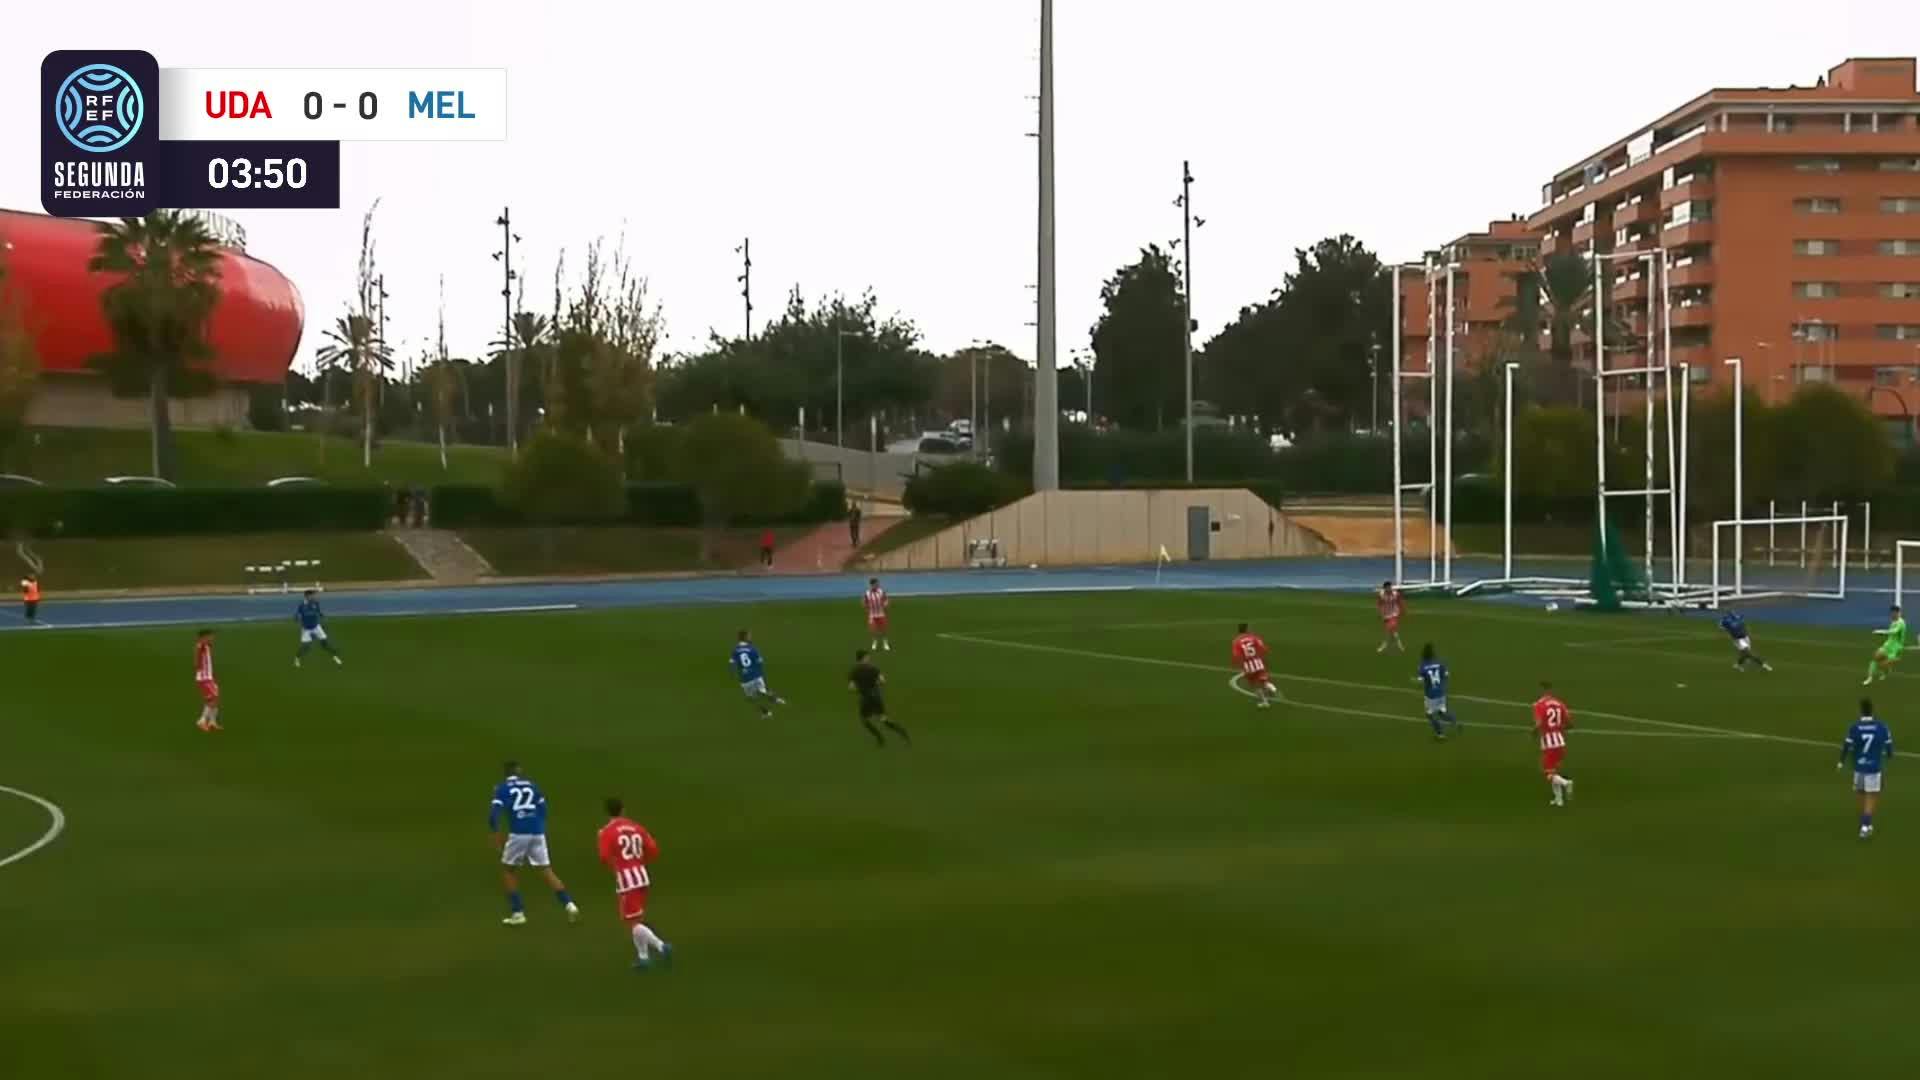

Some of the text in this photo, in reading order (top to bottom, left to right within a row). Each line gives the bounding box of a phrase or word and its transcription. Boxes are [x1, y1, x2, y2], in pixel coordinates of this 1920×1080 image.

[1241, 641, 1256, 657] 15
[740, 652, 752, 668] 6
[1428, 669, 1441, 686] 14
[1546, 707, 1562, 727] 21
[1861, 733, 1875, 754] 7
[509, 787, 536, 811] 22
[618, 833, 643, 860] 20
